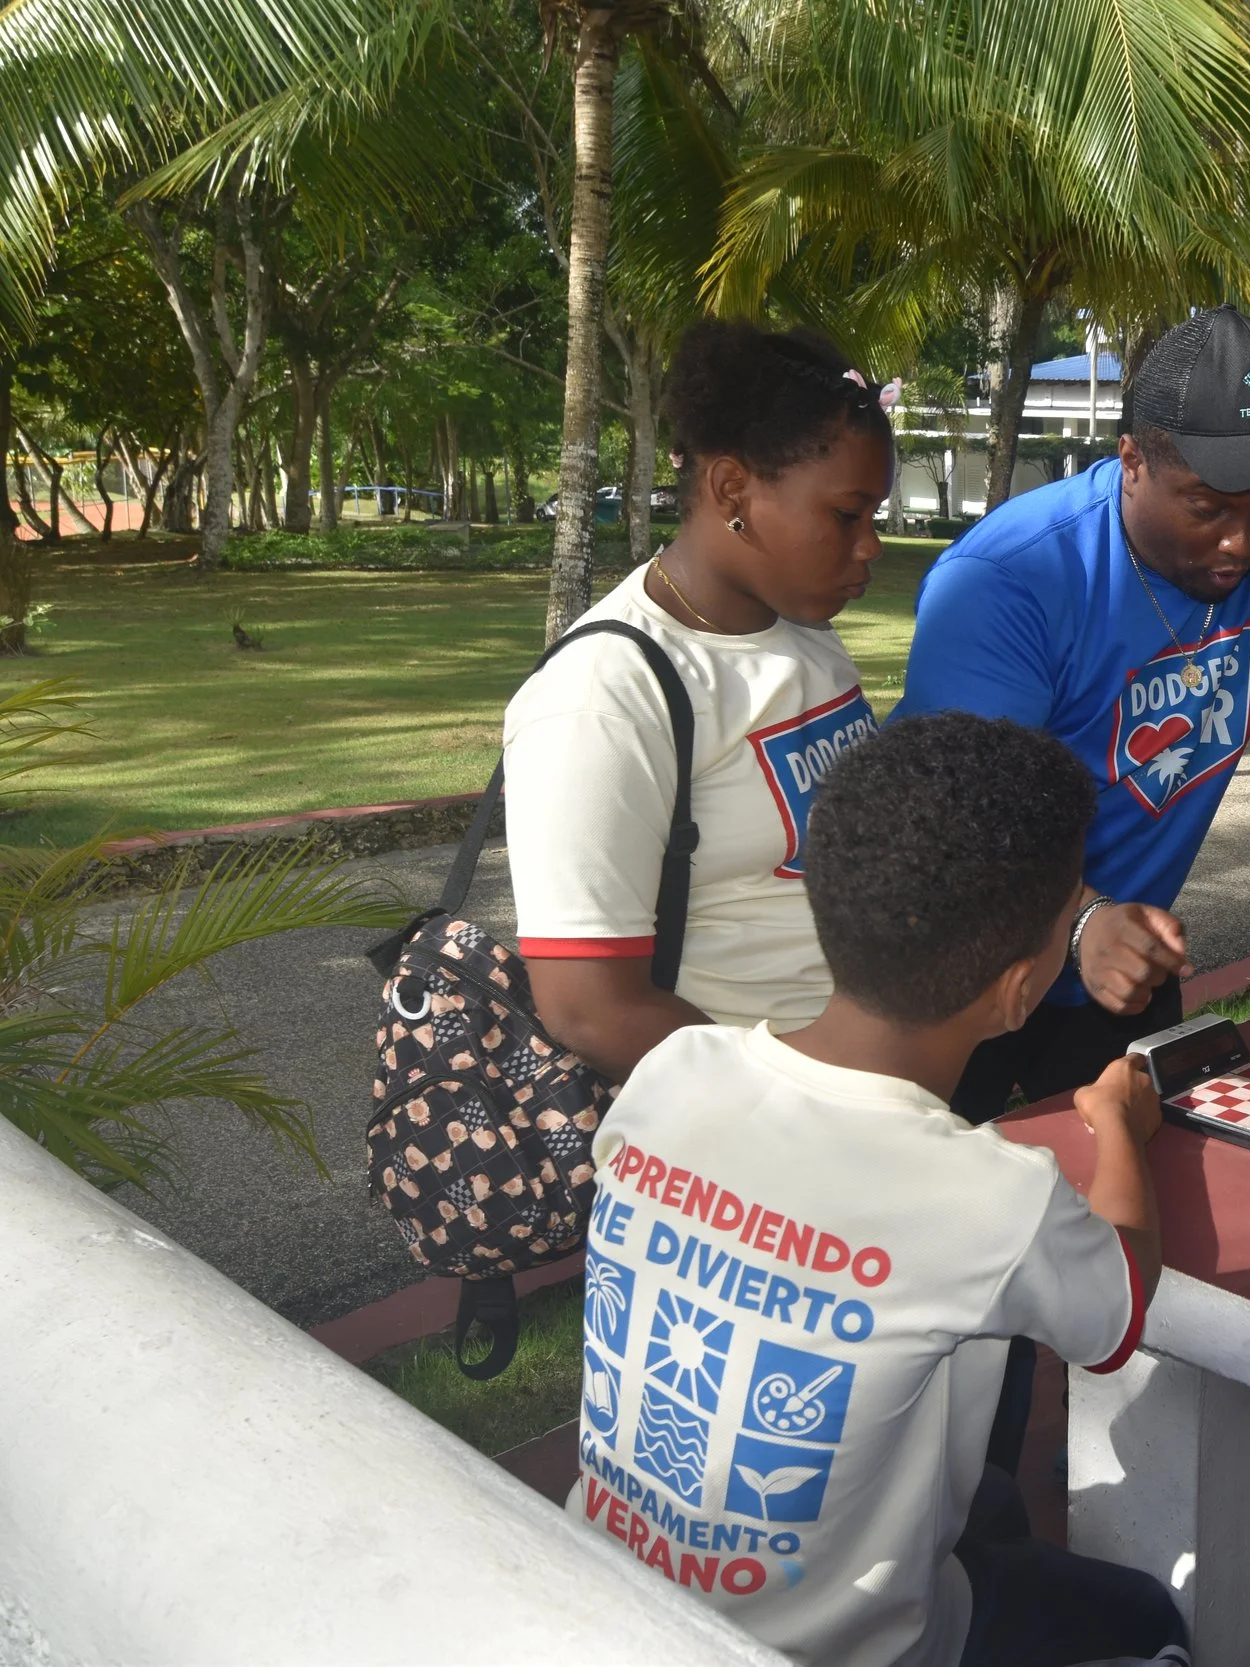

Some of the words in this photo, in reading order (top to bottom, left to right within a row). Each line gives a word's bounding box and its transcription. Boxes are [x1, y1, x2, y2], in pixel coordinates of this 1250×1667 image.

[1131, 645, 1239, 717] DODGE
[593, 1182, 635, 1246] ME
[645, 1220, 875, 1343] DIVIERTO
[609, 1139, 892, 1288] APRENDIENDO
[580, 1430, 801, 1556] CAMPAMENTO
[586, 1475, 767, 1595] VERANO
